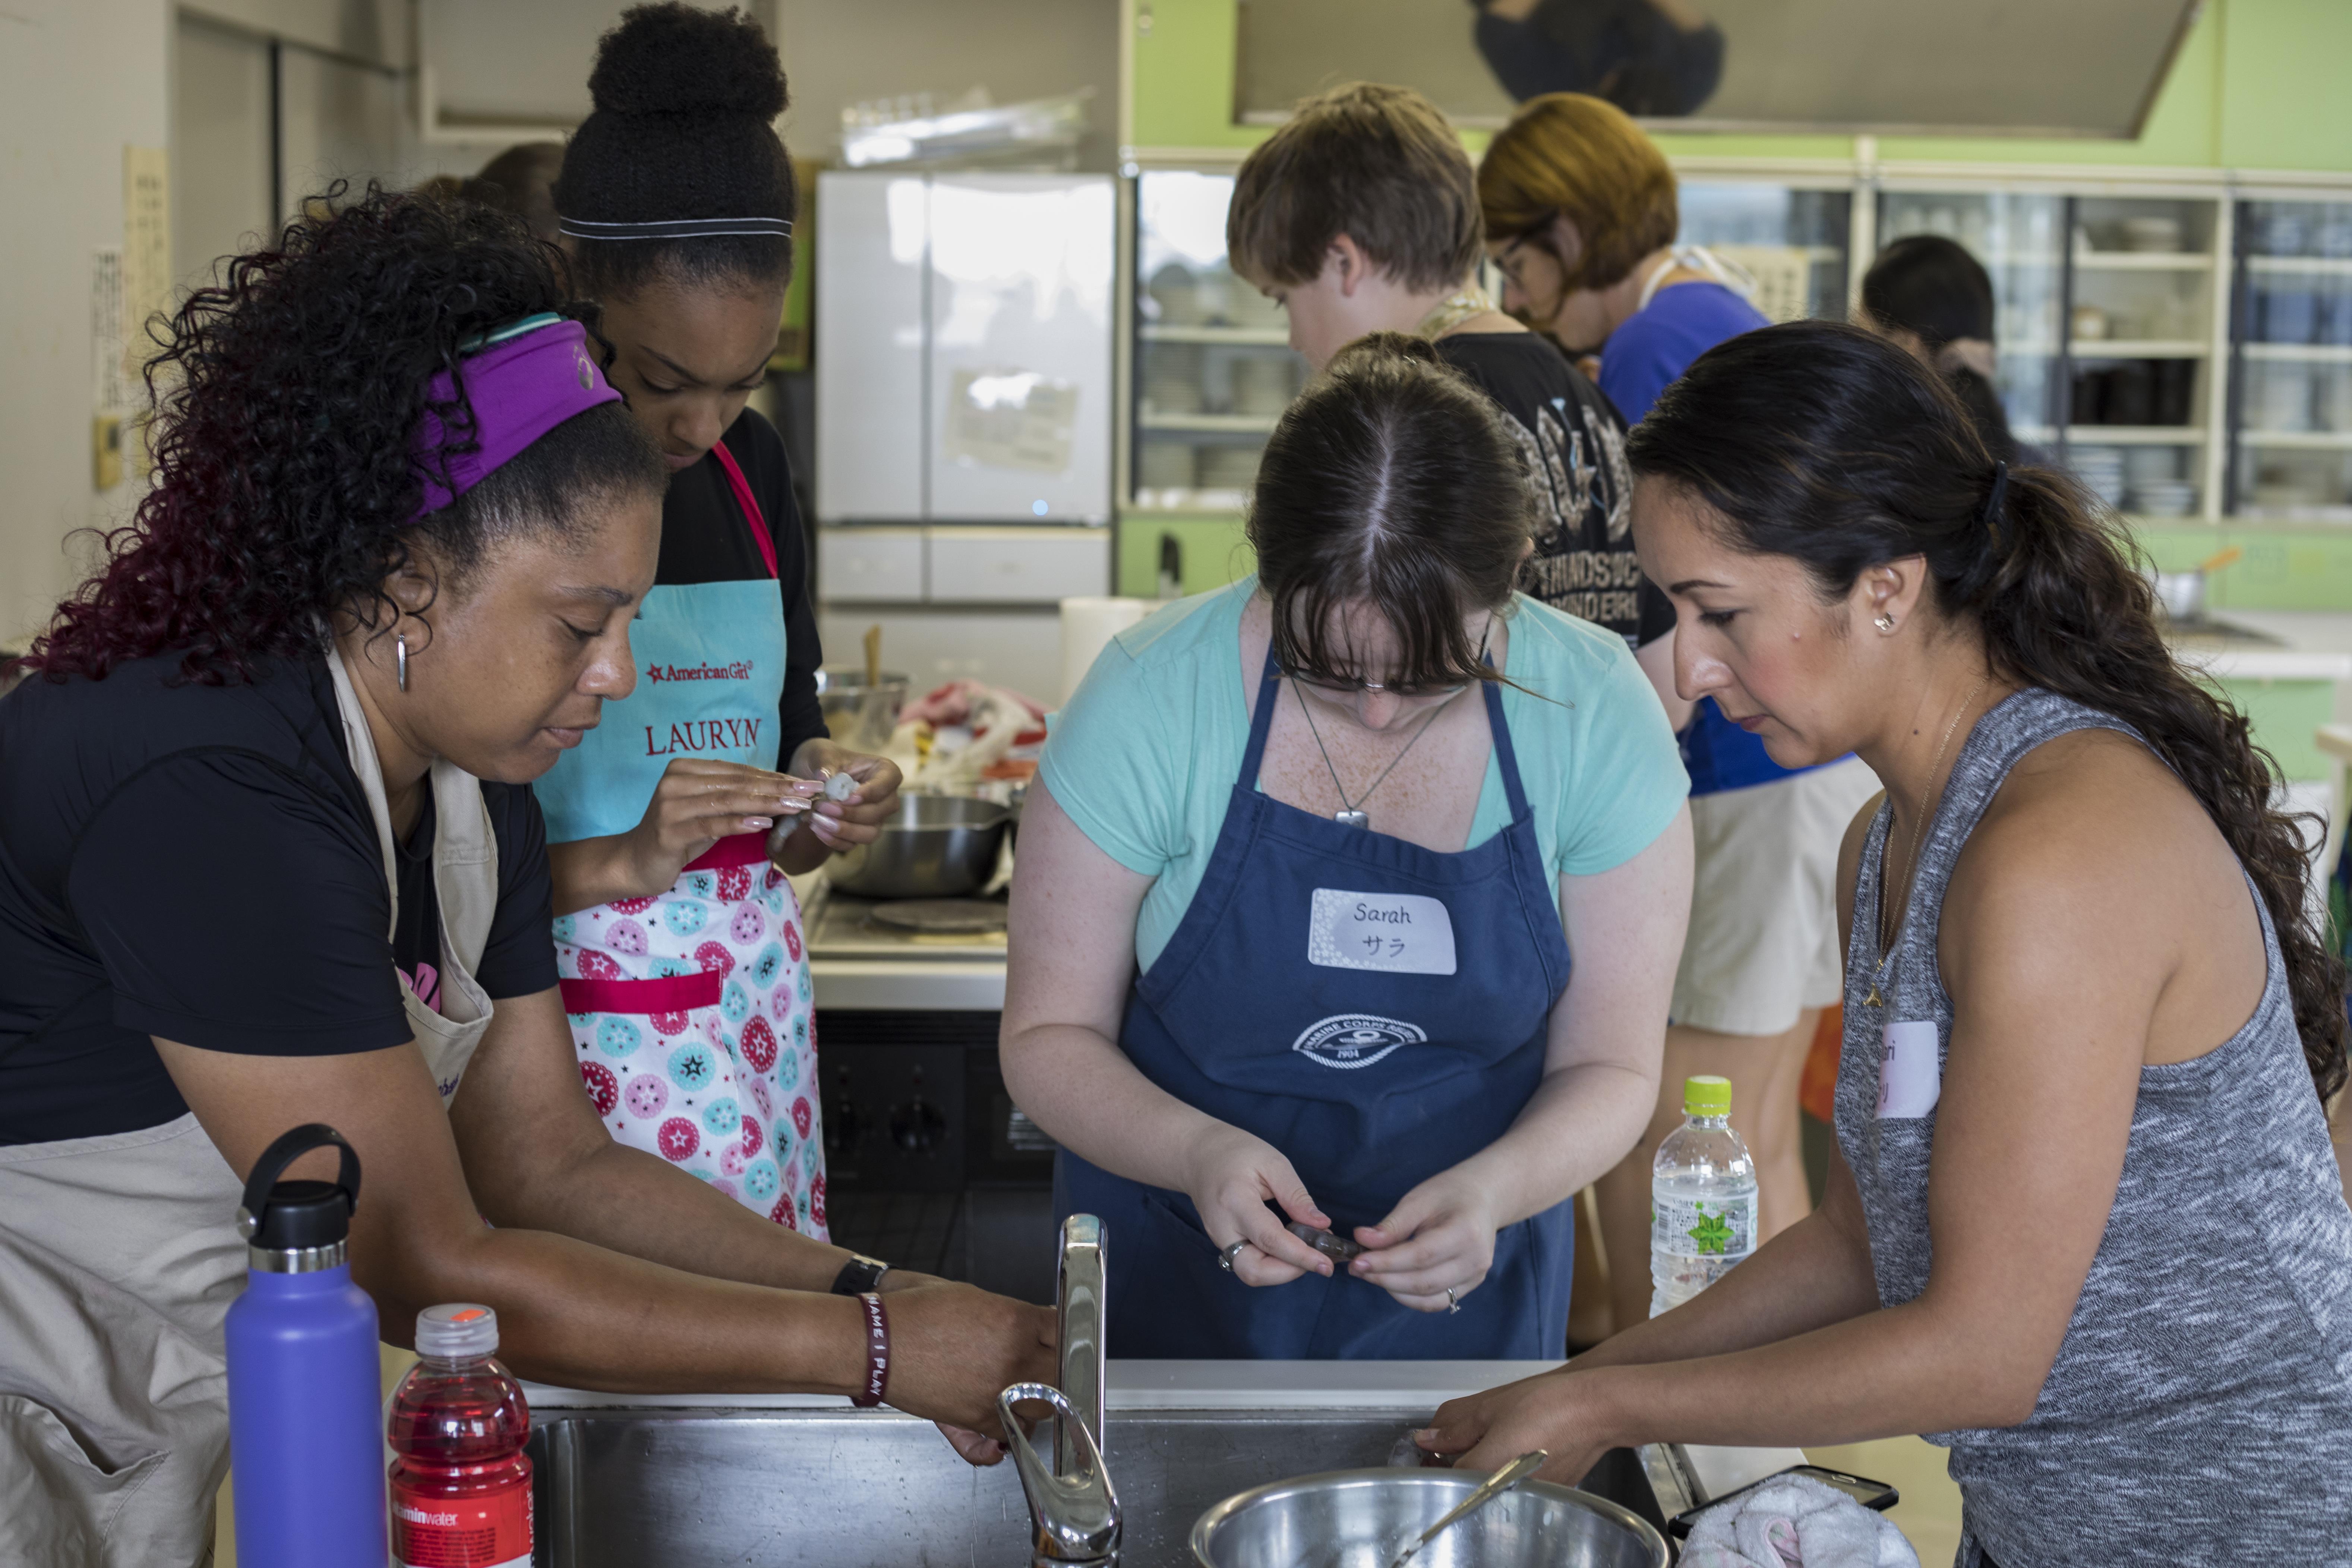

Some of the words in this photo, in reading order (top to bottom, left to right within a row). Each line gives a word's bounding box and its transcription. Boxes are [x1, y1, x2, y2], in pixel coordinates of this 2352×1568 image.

[665, 662, 729, 682] American
[645, 718, 762, 756] LAURYN
[1354, 902, 1412, 924] Sarah
[1362, 935, 1405, 958] サラ
[870, 1357, 886, 1396] PLAY
